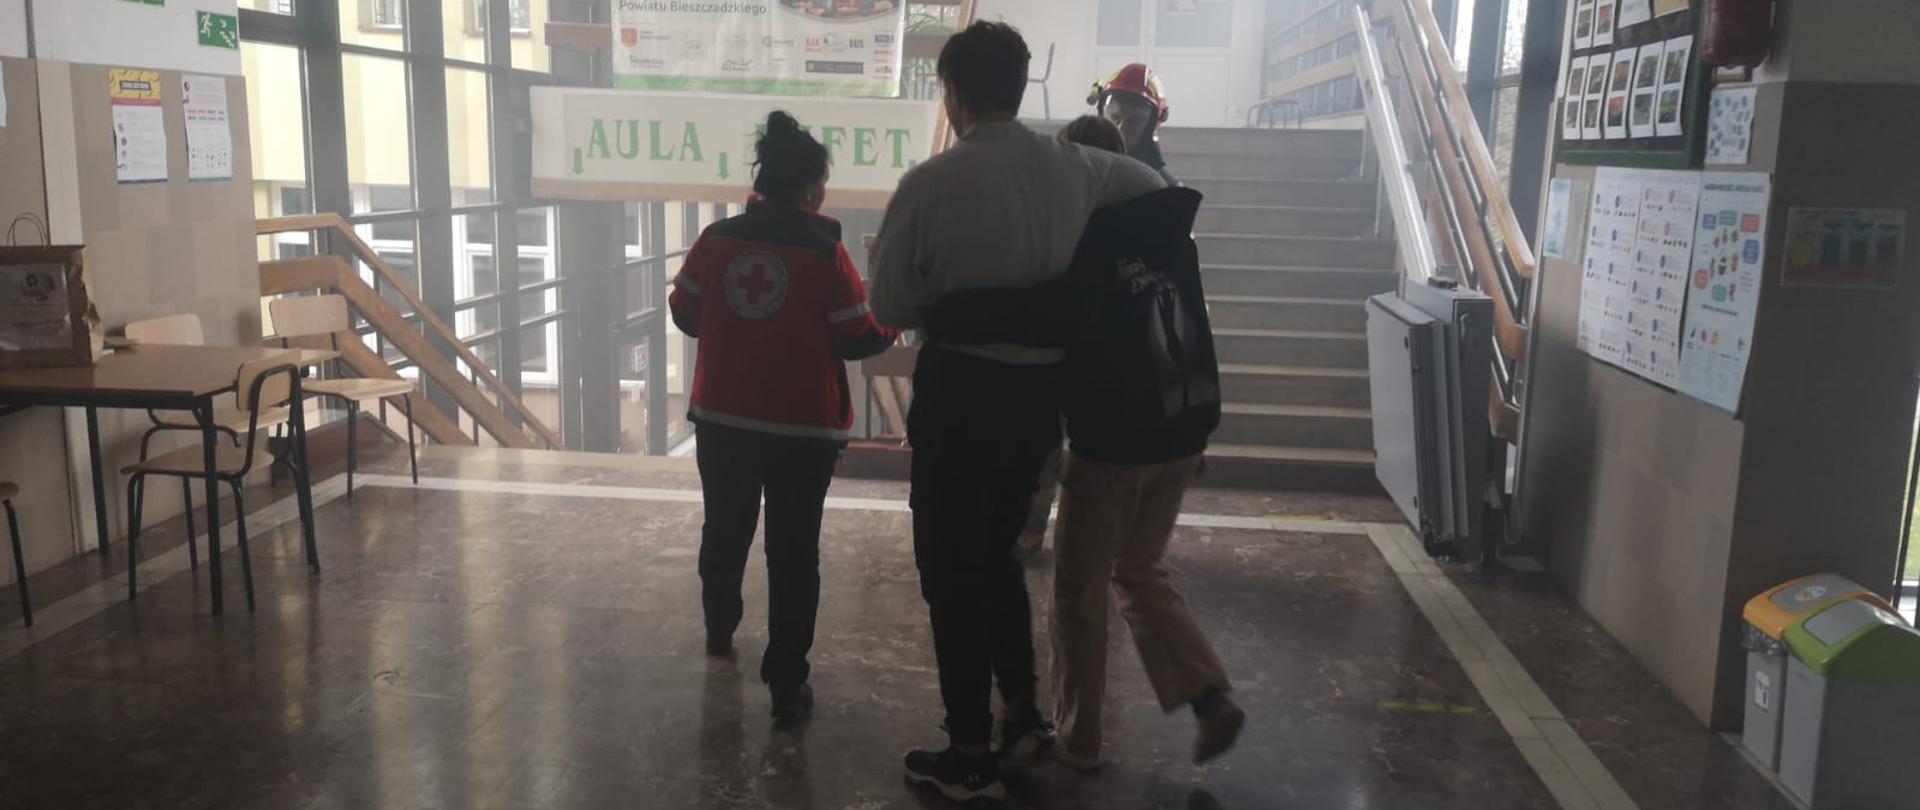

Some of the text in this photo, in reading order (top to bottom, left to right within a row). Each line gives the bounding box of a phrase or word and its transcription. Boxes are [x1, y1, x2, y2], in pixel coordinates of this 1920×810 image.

[619, 0, 767, 15] Powiatu Bieszczadzkiego
[586, 118, 912, 168] AULA FET
